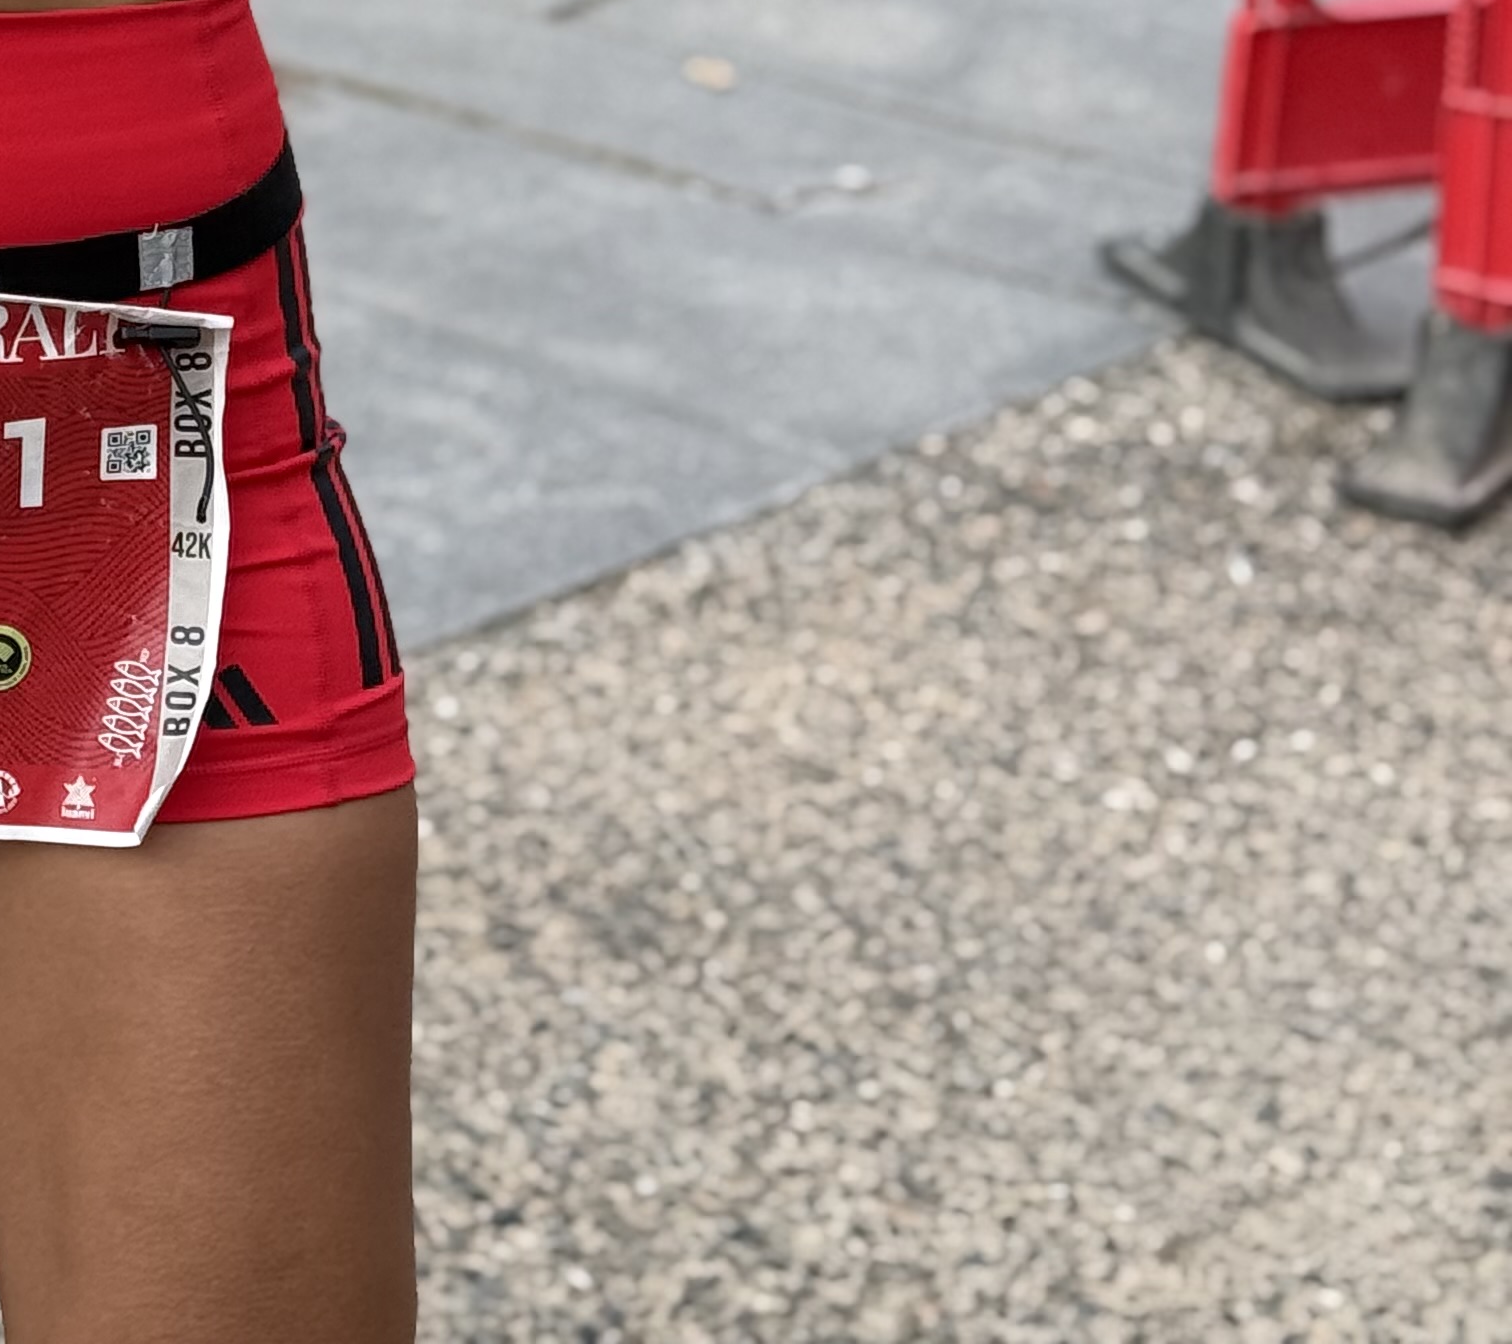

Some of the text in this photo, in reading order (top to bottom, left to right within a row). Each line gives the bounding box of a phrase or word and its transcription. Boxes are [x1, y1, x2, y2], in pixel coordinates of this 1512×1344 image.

[174, 351, 212, 459] BOX 8
[172, 530, 212, 561] 42K
[162, 625, 205, 737] BOX 8
